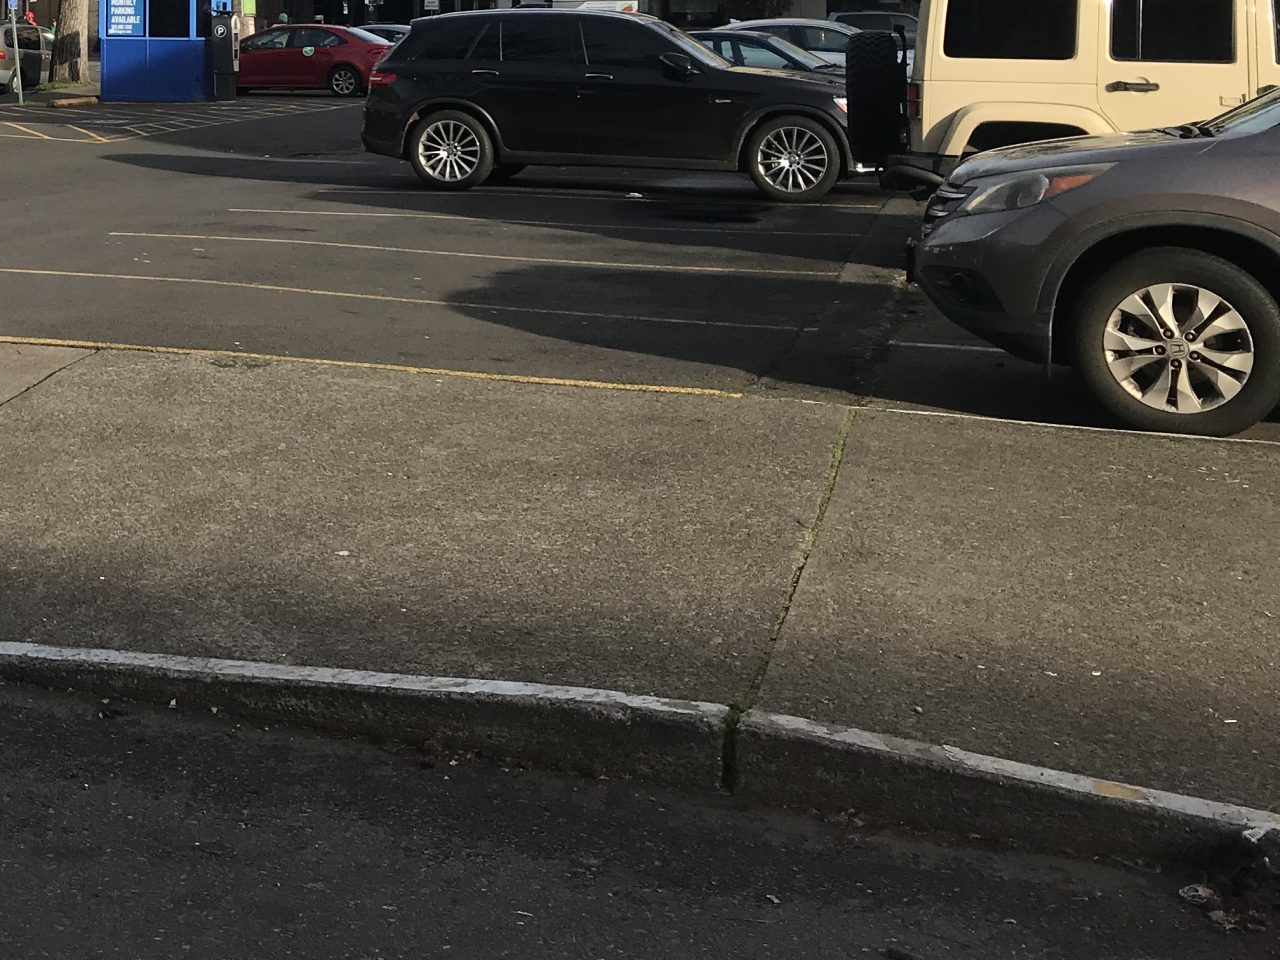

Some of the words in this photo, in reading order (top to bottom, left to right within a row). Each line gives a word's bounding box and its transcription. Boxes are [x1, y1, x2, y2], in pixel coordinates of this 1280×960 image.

[111, 6, 135, 15] PARKING
[111, 15, 141, 24] AVAILABLE
[217, 27, 224, 36] P
